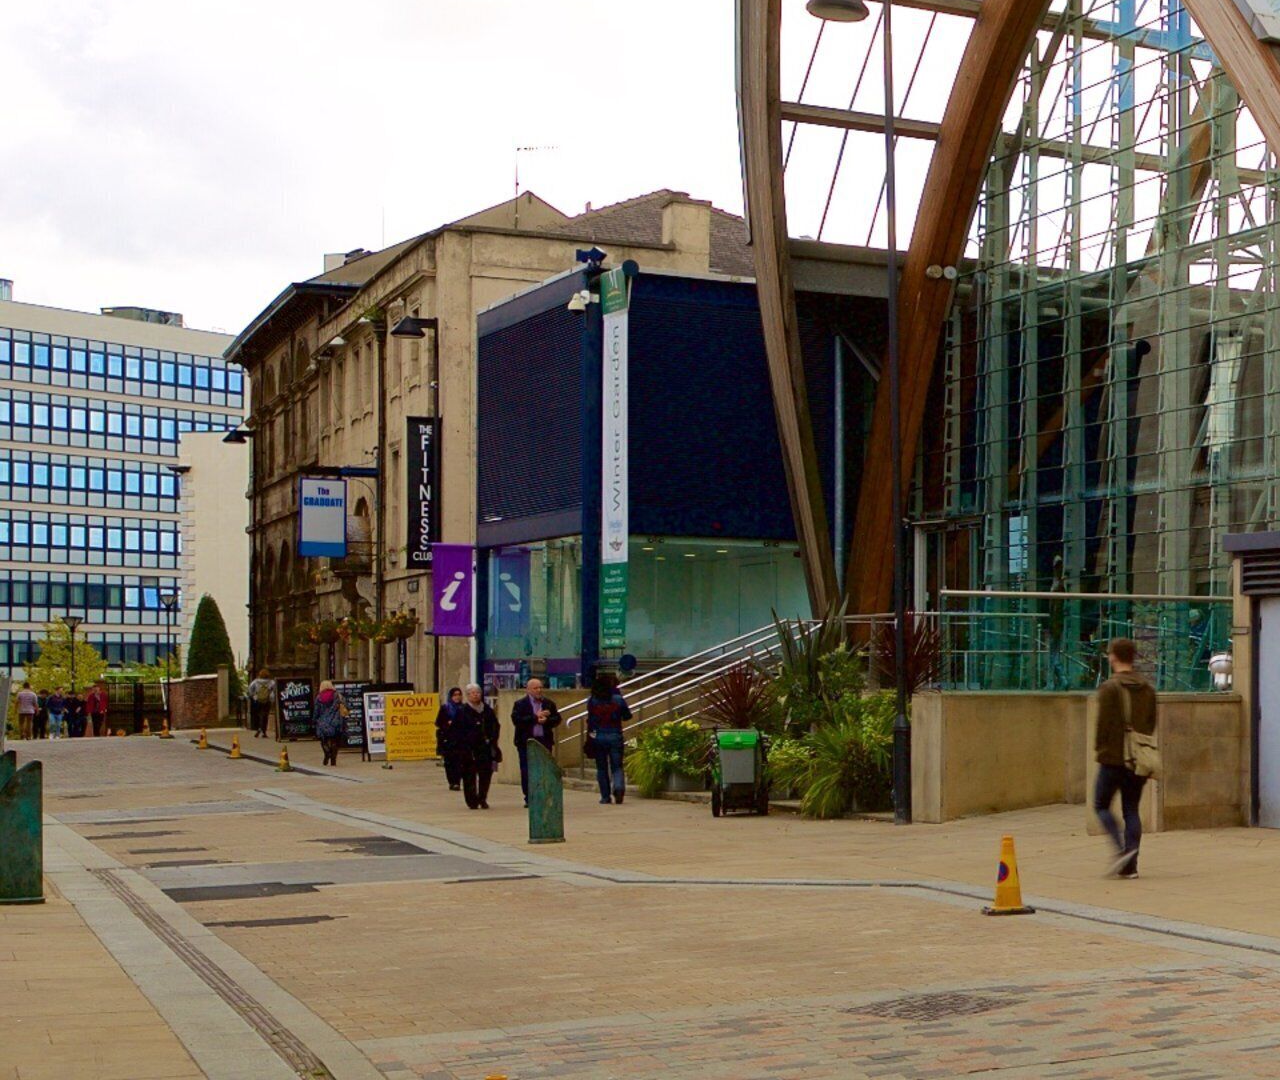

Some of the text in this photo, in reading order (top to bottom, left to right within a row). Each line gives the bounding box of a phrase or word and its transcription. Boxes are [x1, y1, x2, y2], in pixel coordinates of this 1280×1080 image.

[612, 325, 620, 418] Garden
[419, 424, 433, 435] THE
[613, 429, 621, 512] Winter
[317, 486, 330, 496] The
[420, 435, 431, 551] FITNESS
[303, 497, 343, 508] GRADUATE
[413, 551, 433, 561] CLUB
[391, 696, 433, 708] WOW!
[390, 715, 409, 726] £10
